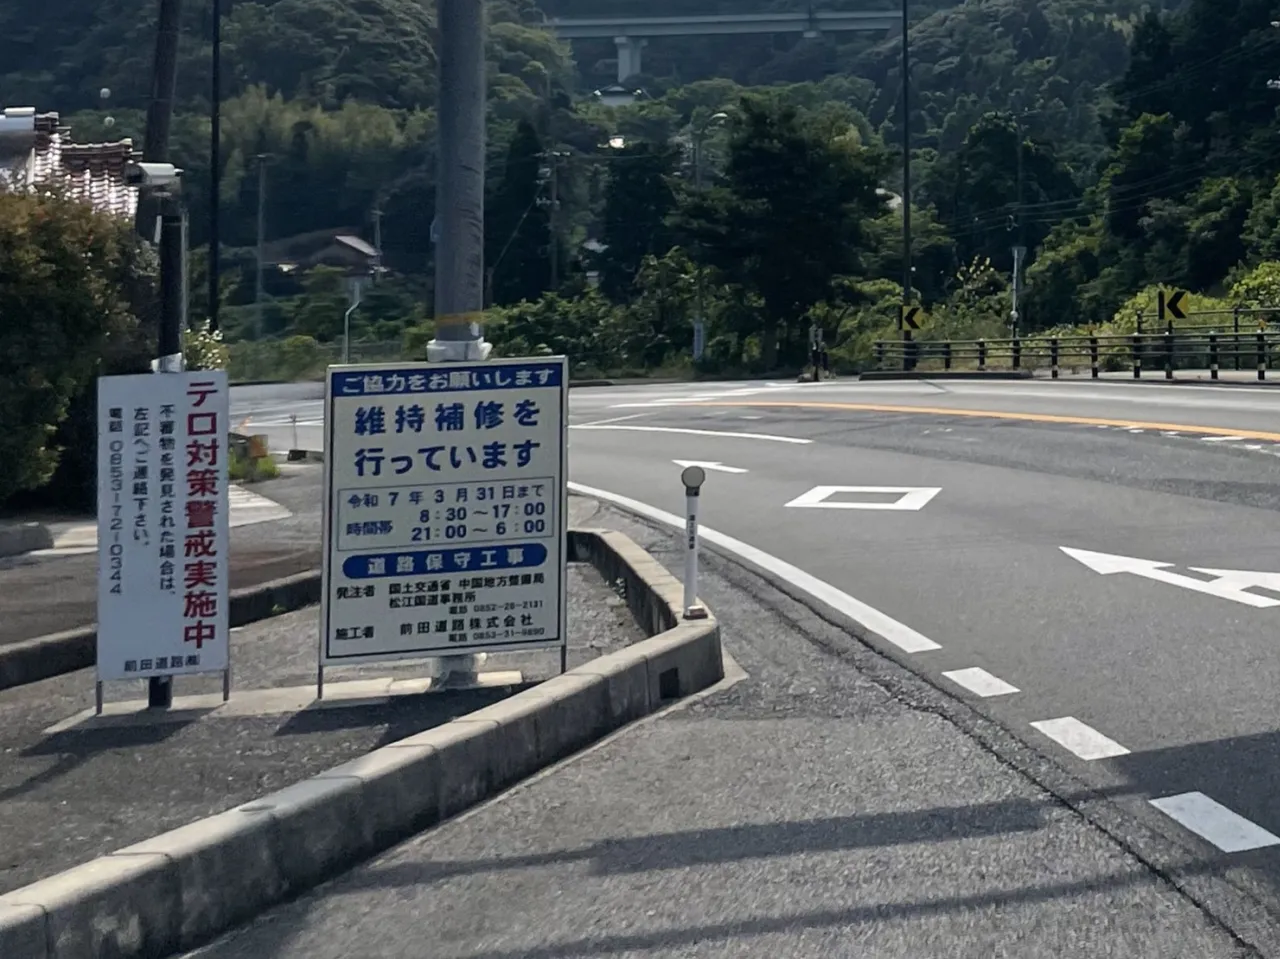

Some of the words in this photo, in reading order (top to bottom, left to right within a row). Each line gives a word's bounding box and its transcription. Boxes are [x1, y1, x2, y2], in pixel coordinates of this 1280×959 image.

[342, 368, 555, 393] ご協力をお願いします
[354, 399, 541, 436] 維持補修を
[354, 439, 541, 477] 行っています
[184, 381, 219, 649] テロ対策警戒実施中
[346, 520, 394, 536] 時間帯
[367, 548, 525, 575] 道路保守工事
[336, 585, 375, 599] 発注者
